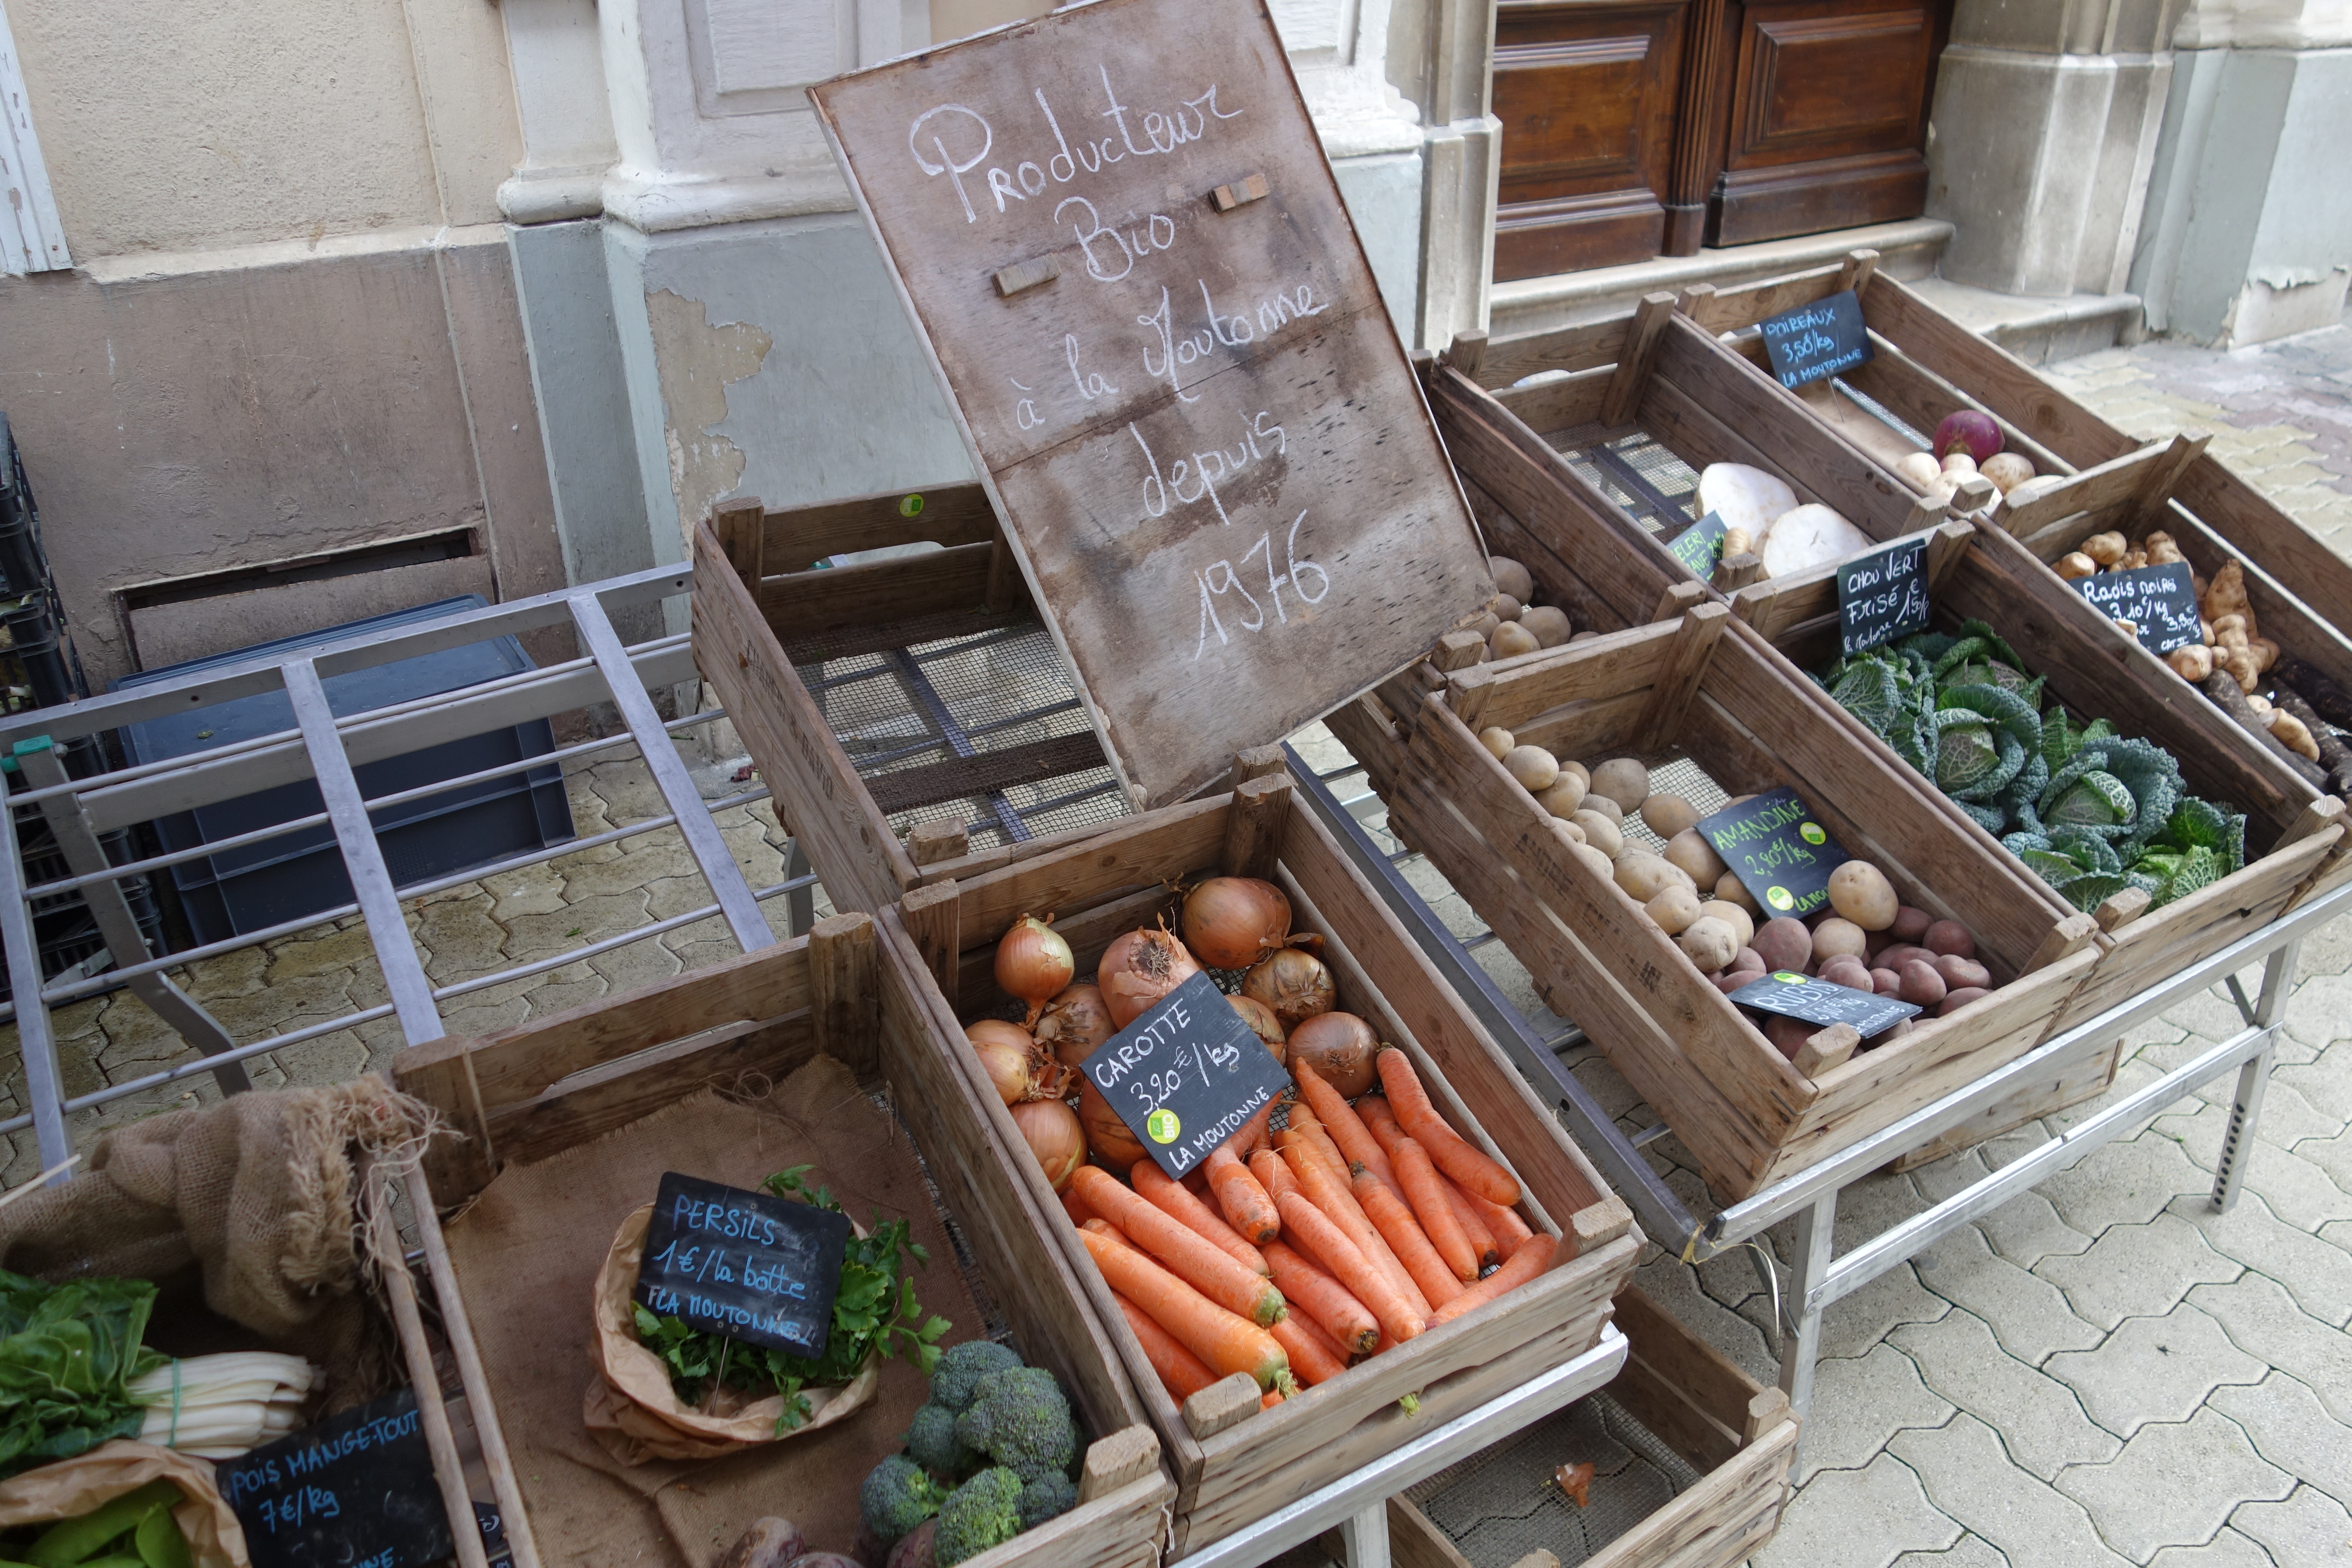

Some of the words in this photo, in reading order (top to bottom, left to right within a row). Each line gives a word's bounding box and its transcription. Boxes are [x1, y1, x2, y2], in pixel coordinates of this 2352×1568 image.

[1054, 196, 1174, 282] Bio
[1011, 377, 1046, 430] à
[1066, 334, 1119, 400] la
[1137, 279, 1329, 403] Moutonne
[1781, 372, 1798, 387] LA
[1801, 349, 1862, 380] MOUTONNE
[1129, 411, 1285, 525] depuis
[1671, 530, 1706, 561] ELERI
[1686, 549, 1710, 573] AVE
[1194, 509, 1329, 661] 1976
[1848, 569, 1880, 594] CHOU
[1886, 545, 1926, 582] VERT
[2083, 574, 2135, 602] Radis
[1794, 896, 1815, 912] LA
[1754, 980, 1839, 1011] RUBIS
[1095, 998, 1191, 1088] CAROTTE
[1164, 1114, 1176, 1139] BIO
[1169, 1146, 1195, 1170] LA
[1193, 1086, 1270, 1152] MOUTONNE
[743, 1255, 806, 1300] botte
